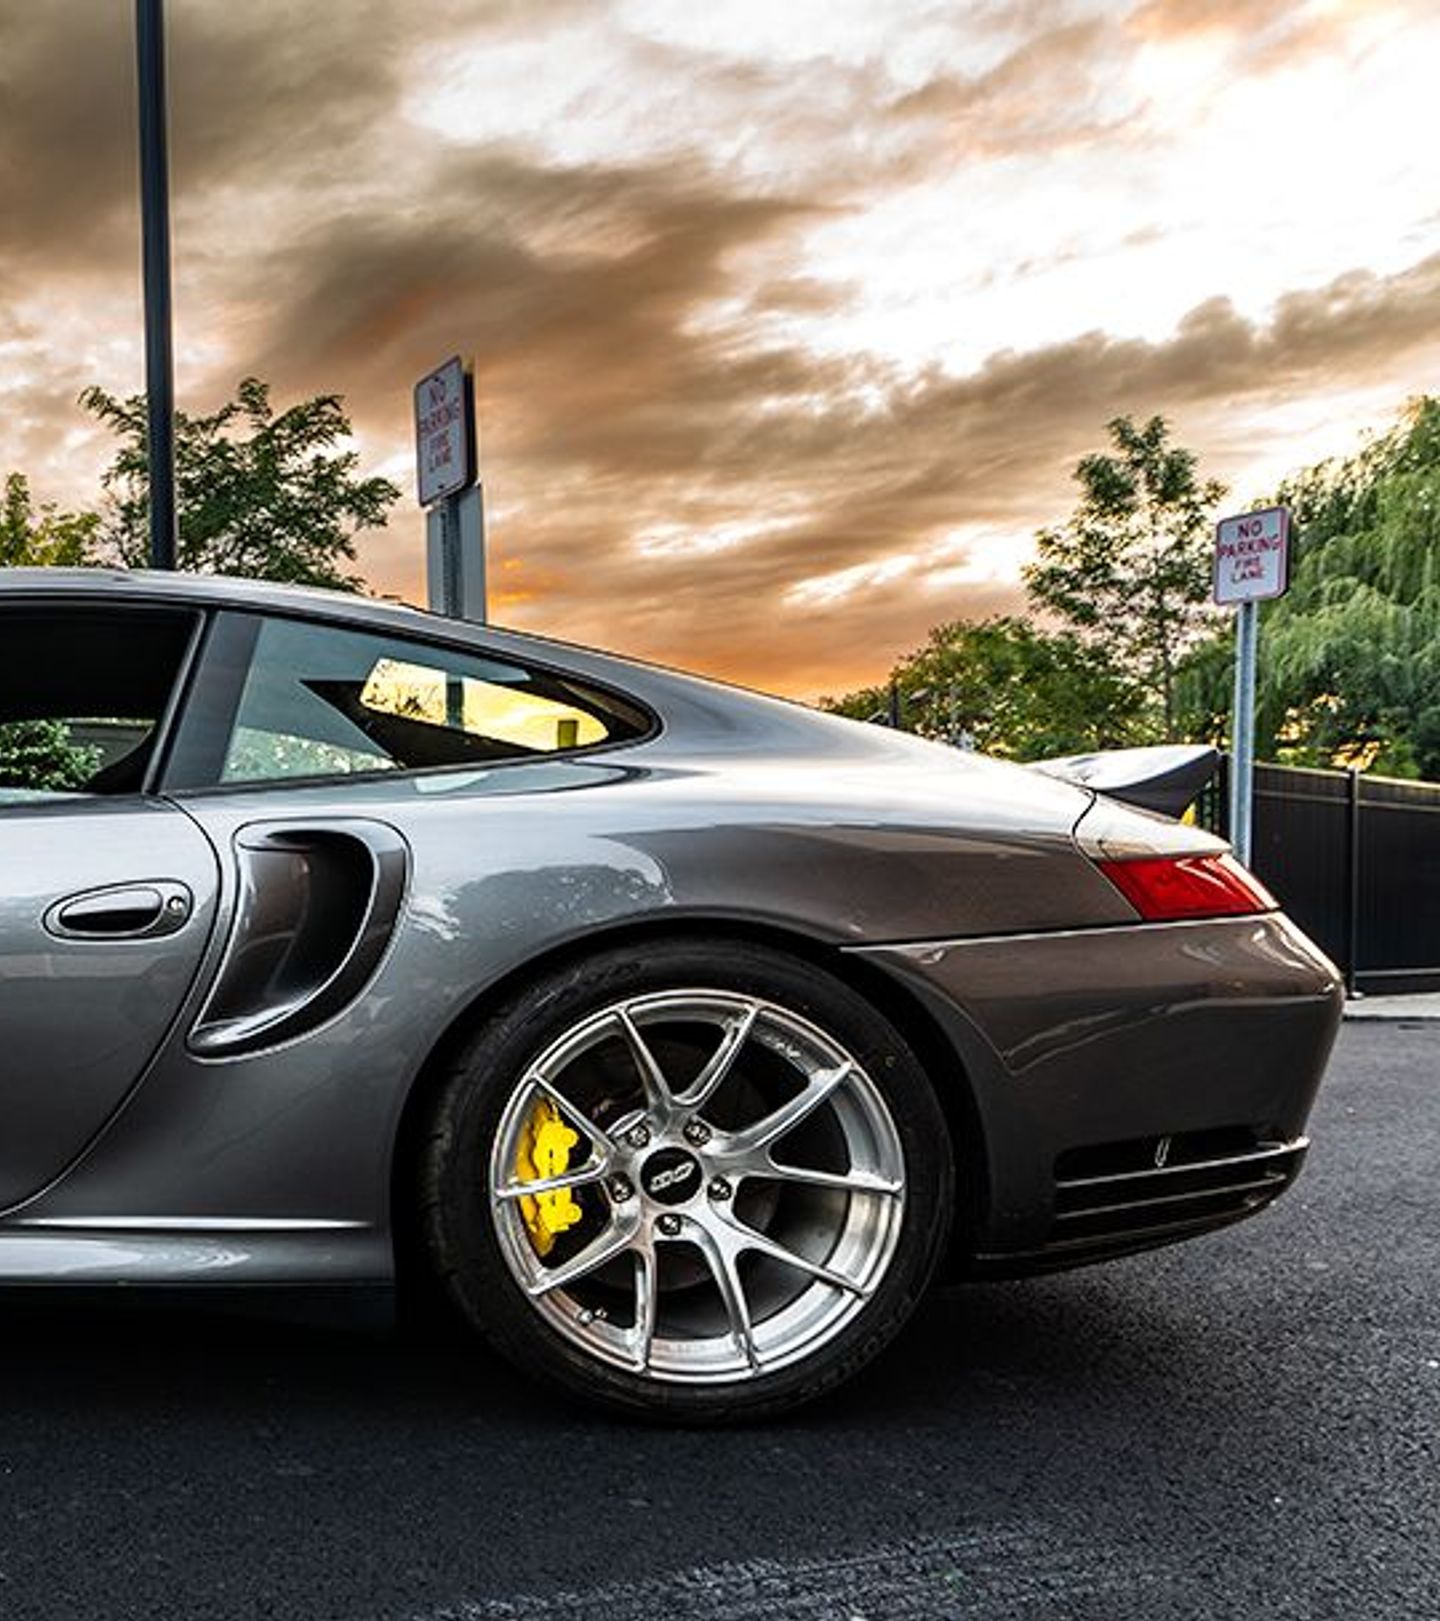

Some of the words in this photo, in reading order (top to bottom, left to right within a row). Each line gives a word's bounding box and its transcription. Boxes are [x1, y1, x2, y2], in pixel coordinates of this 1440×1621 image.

[1237, 520, 1262, 538] NO
[1219, 533, 1281, 558] PARKING
[1234, 556, 1260, 570] FIRE
[1230, 566, 1264, 584] LANE
